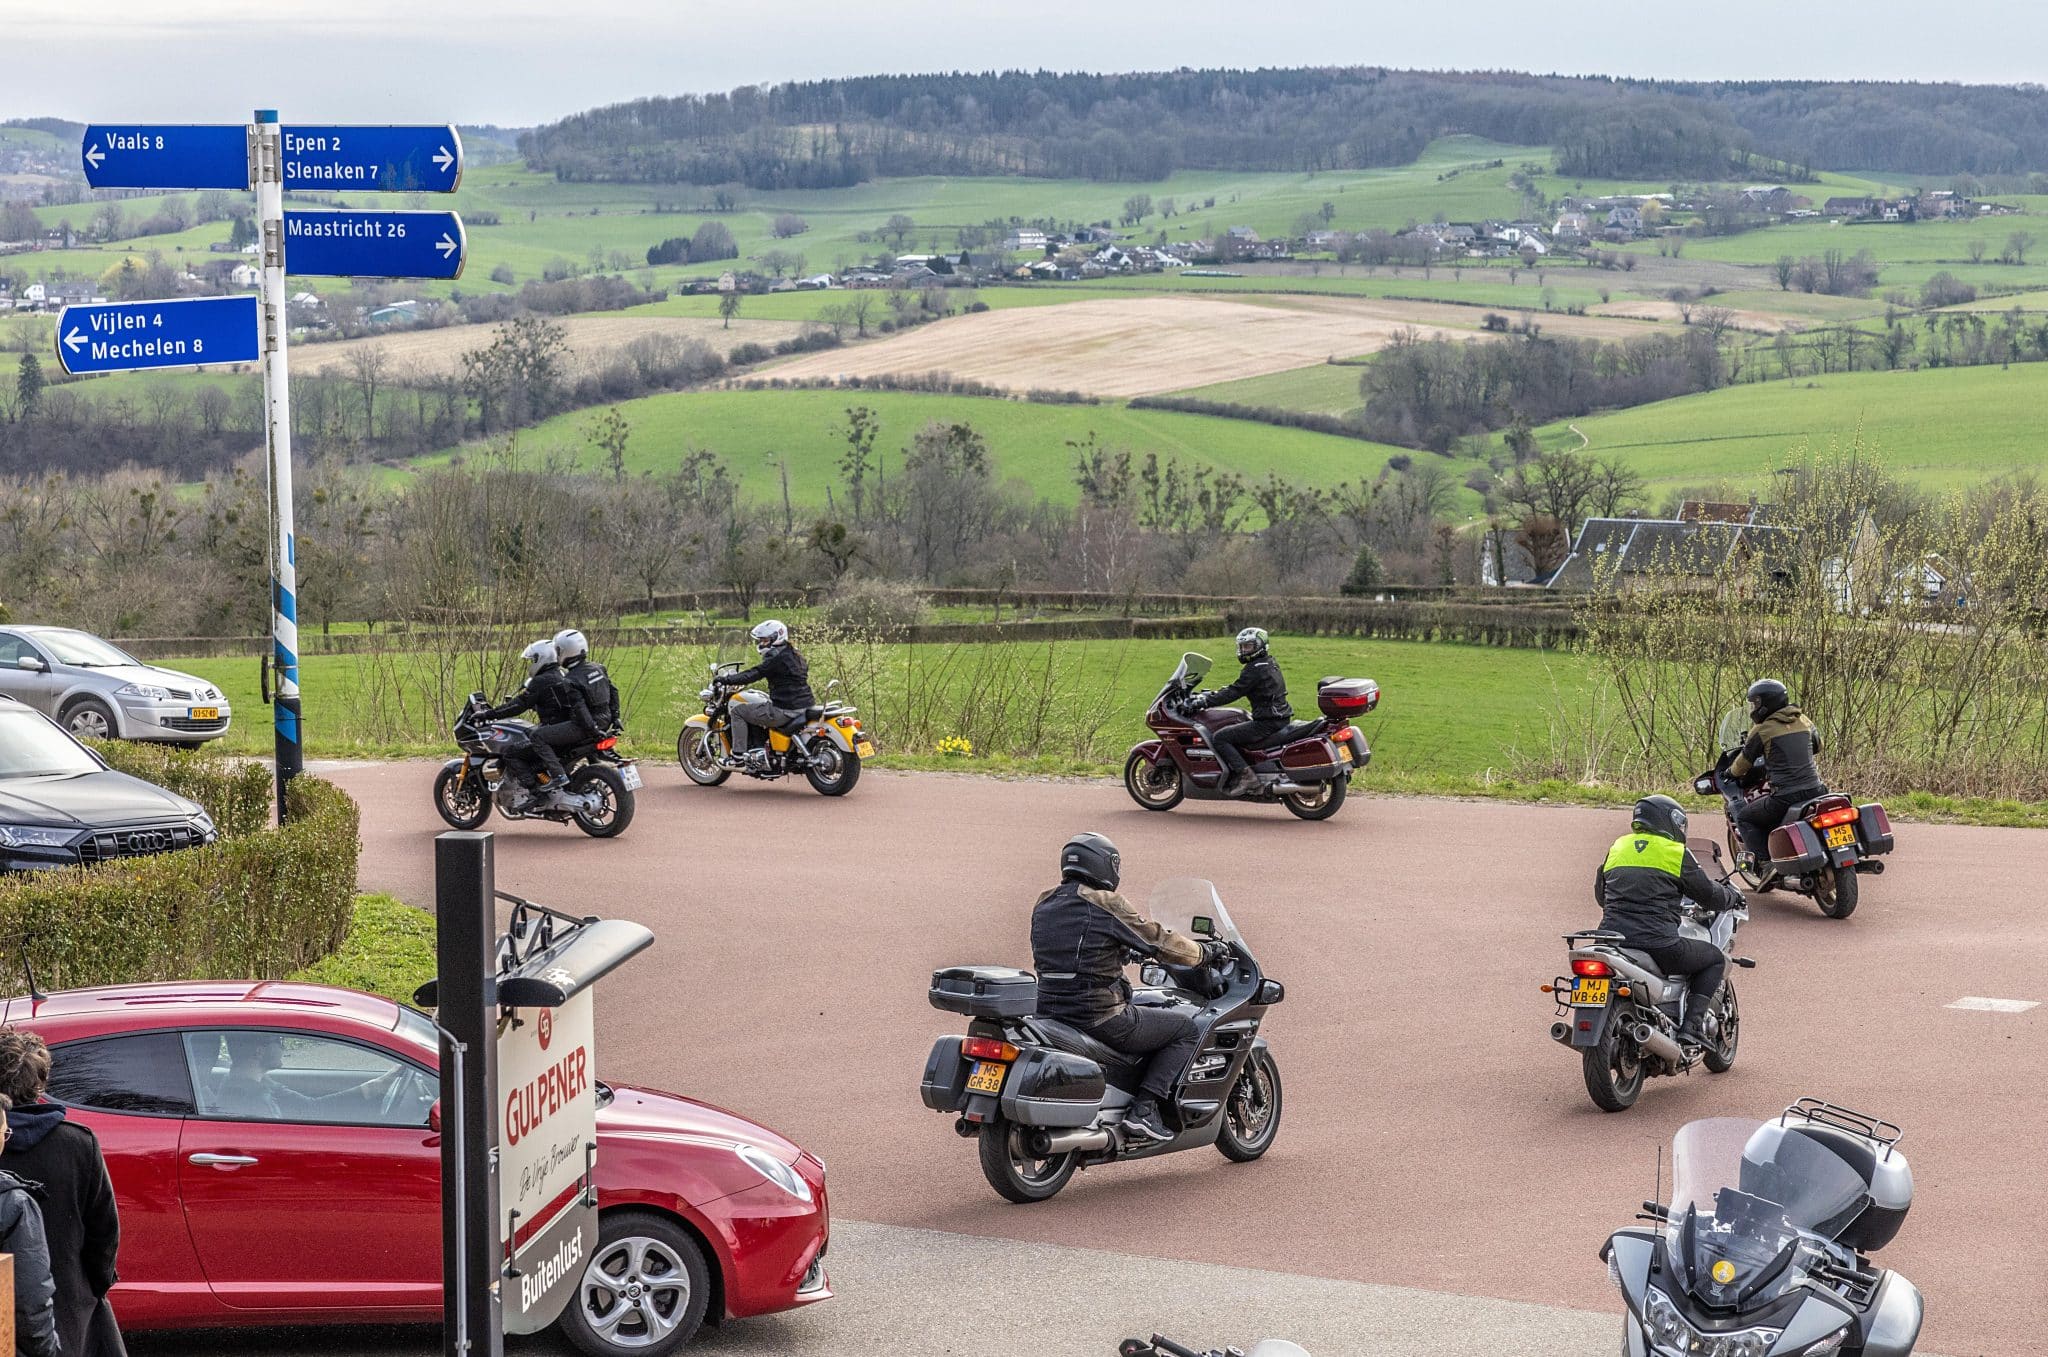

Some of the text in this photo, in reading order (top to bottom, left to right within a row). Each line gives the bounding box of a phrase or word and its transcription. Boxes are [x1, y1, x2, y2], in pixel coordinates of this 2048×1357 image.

[106, 132, 164, 150] Vaals 8
[285, 133, 341, 155] Epen 2
[286, 161, 378, 180] Slenaken 7
[288, 219, 406, 238] Maastricht 26
[90, 312, 163, 335] Vijlen 4
[91, 338, 203, 360] Mechelen 8
[1833, 826, 1847, 836] MS
[1586, 980, 1602, 991] MJ
[1573, 991, 1606, 1002] VB-68
[983, 1063, 999, 1077] MS
[970, 1076, 1000, 1091] GR-38
[506, 1045, 587, 1146] GULPENER
[521, 1225, 583, 1314] Buitenlust
